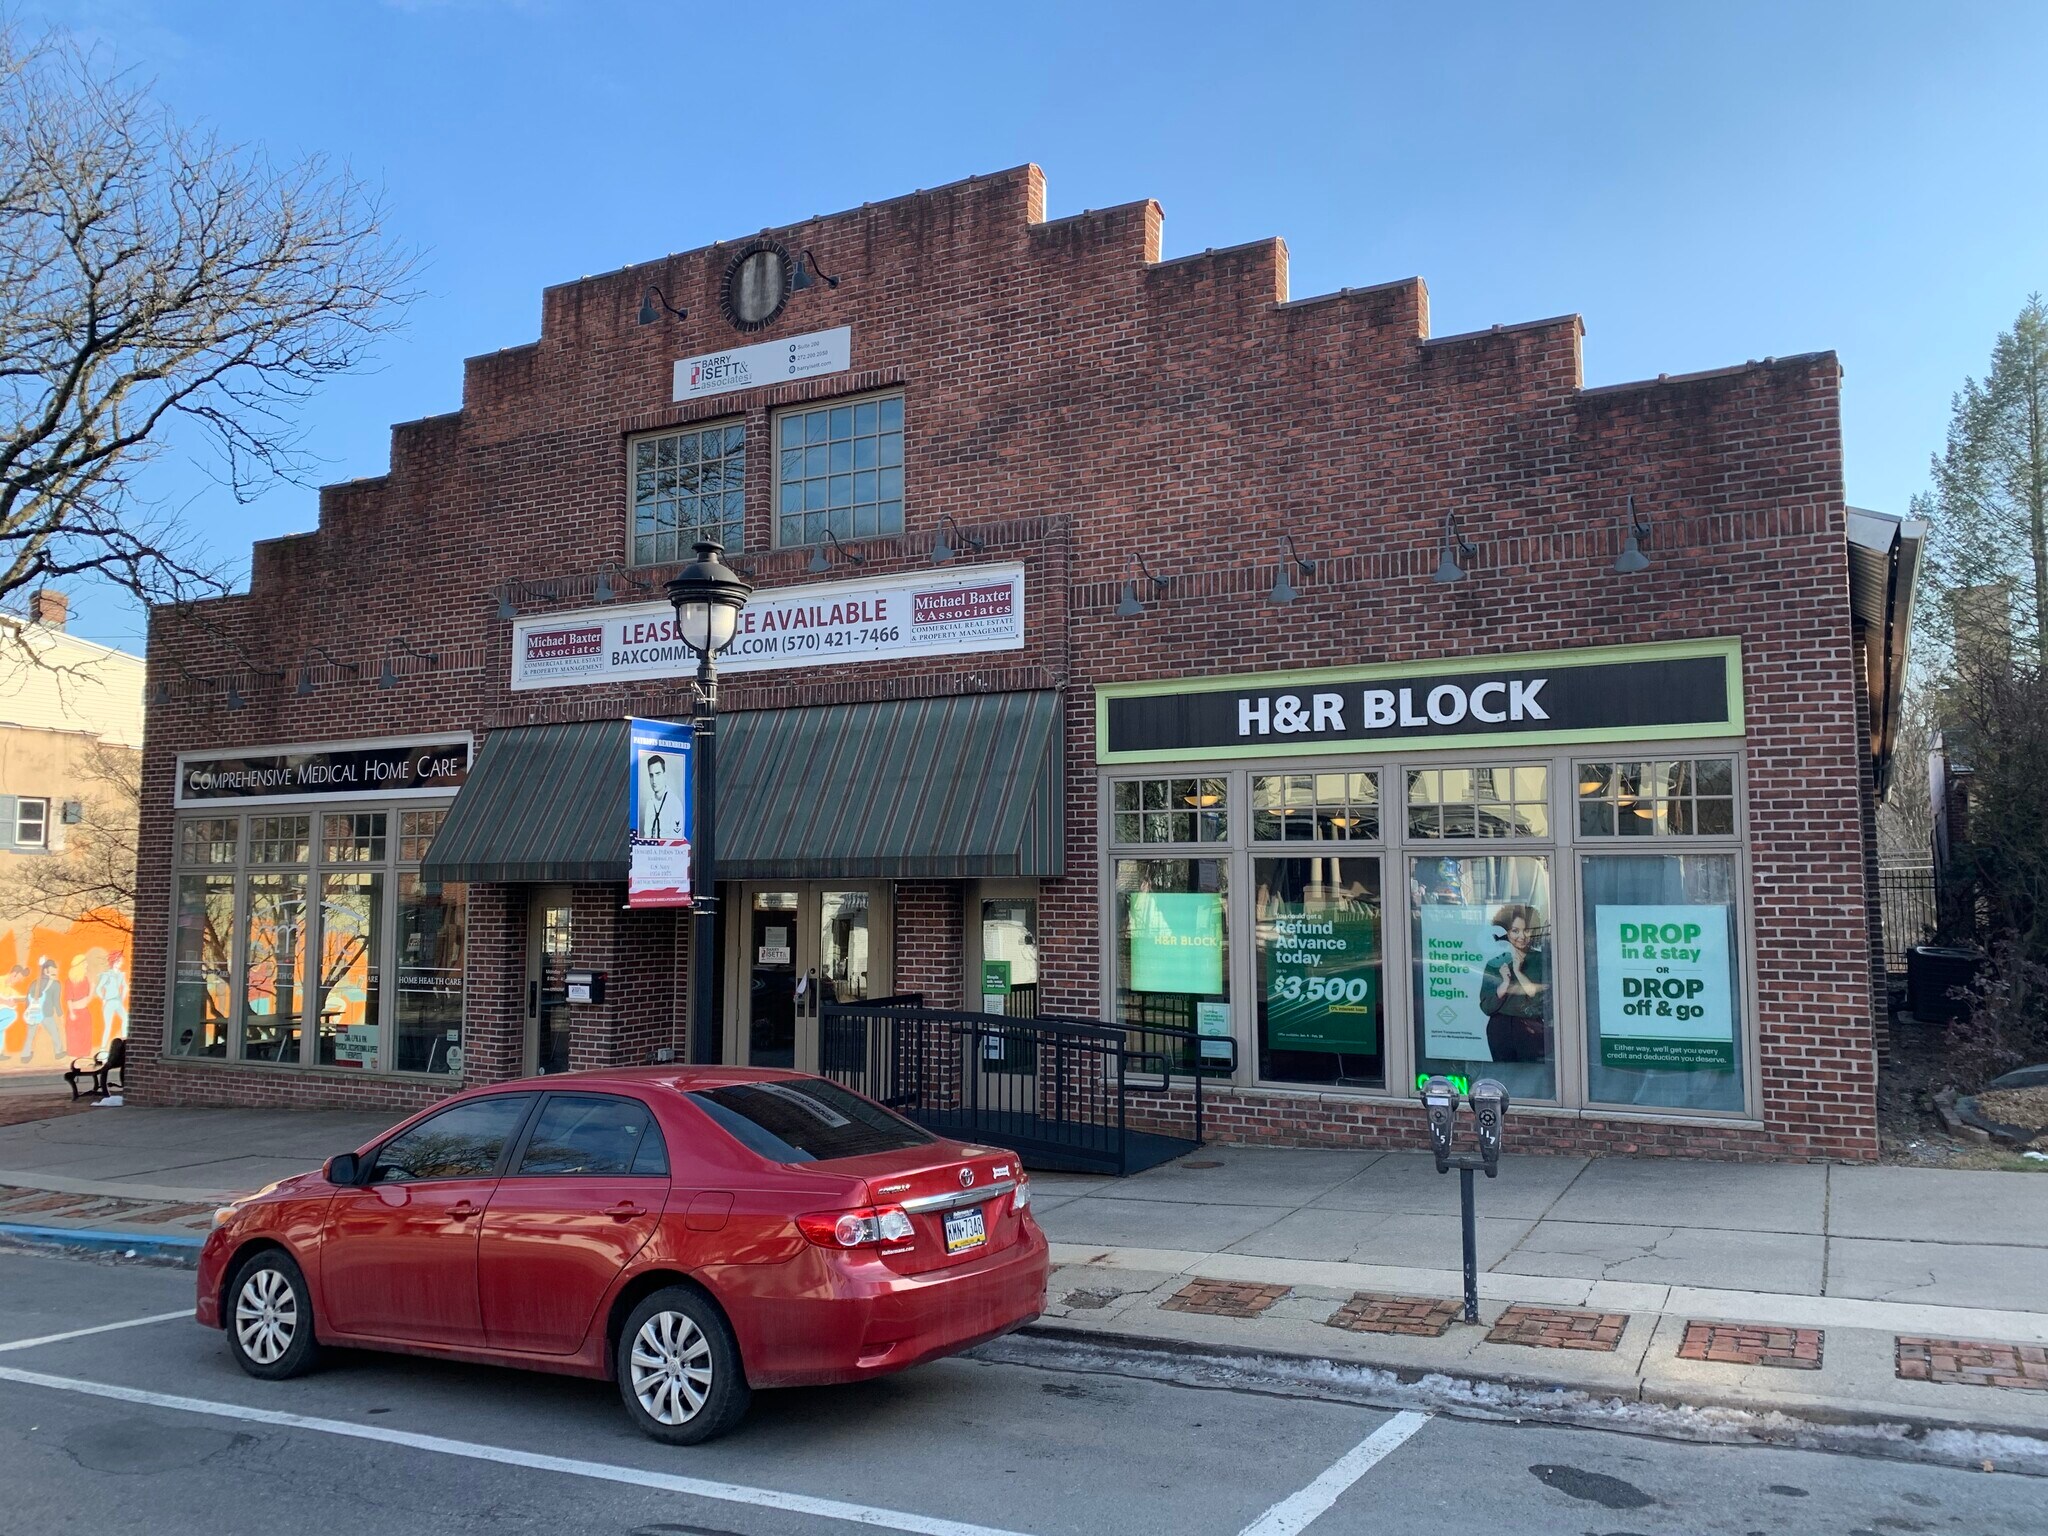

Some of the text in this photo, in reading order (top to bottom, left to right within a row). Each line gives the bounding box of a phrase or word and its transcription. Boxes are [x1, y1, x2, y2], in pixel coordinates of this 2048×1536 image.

[702, 355, 731, 368] BARRY
[701, 374, 748, 390] associates
[915, 590, 1011, 610] Michael Baxter
[622, 621, 682, 645] LEASE
[762, 599, 887, 632] AVAILABLE
[912, 624, 962, 634] COMMERCIAL
[987, 618, 1014, 626] ESTATE
[528, 633, 602, 648] Michael Baxter
[782, 632, 820, 653] (570)
[824, 626, 899, 647] 421-7466
[920, 632, 956, 640] PROPERTY
[960, 626, 1014, 637] MANAGEMENT
[524, 660, 562, 668] COMMERCIAL
[1238, 679, 1550, 736] H&R BLOCK
[364, 760, 409, 780] HOME
[416, 755, 458, 778] CARE
[1276, 920, 1333, 934] Refund
[1620, 924, 1702, 944] DROP
[1154, 936, 1217, 947] H&R BLOCK
[1276, 937, 1347, 950] Advance
[1428, 938, 1463, 948] Know
[1276, 951, 1324, 968] today.
[1428, 950, 1483, 963] the price
[1622, 944, 1702, 963] in & stay
[1429, 963, 1470, 974] before
[398, 976, 462, 986] HOME HEALTH CARE
[1274, 975, 1368, 1002] $3,500
[1430, 977, 1452, 987] you
[1622, 978, 1704, 999] DROP
[1430, 987, 1468, 1000] begin.
[1623, 1000, 1704, 1021] off & go
